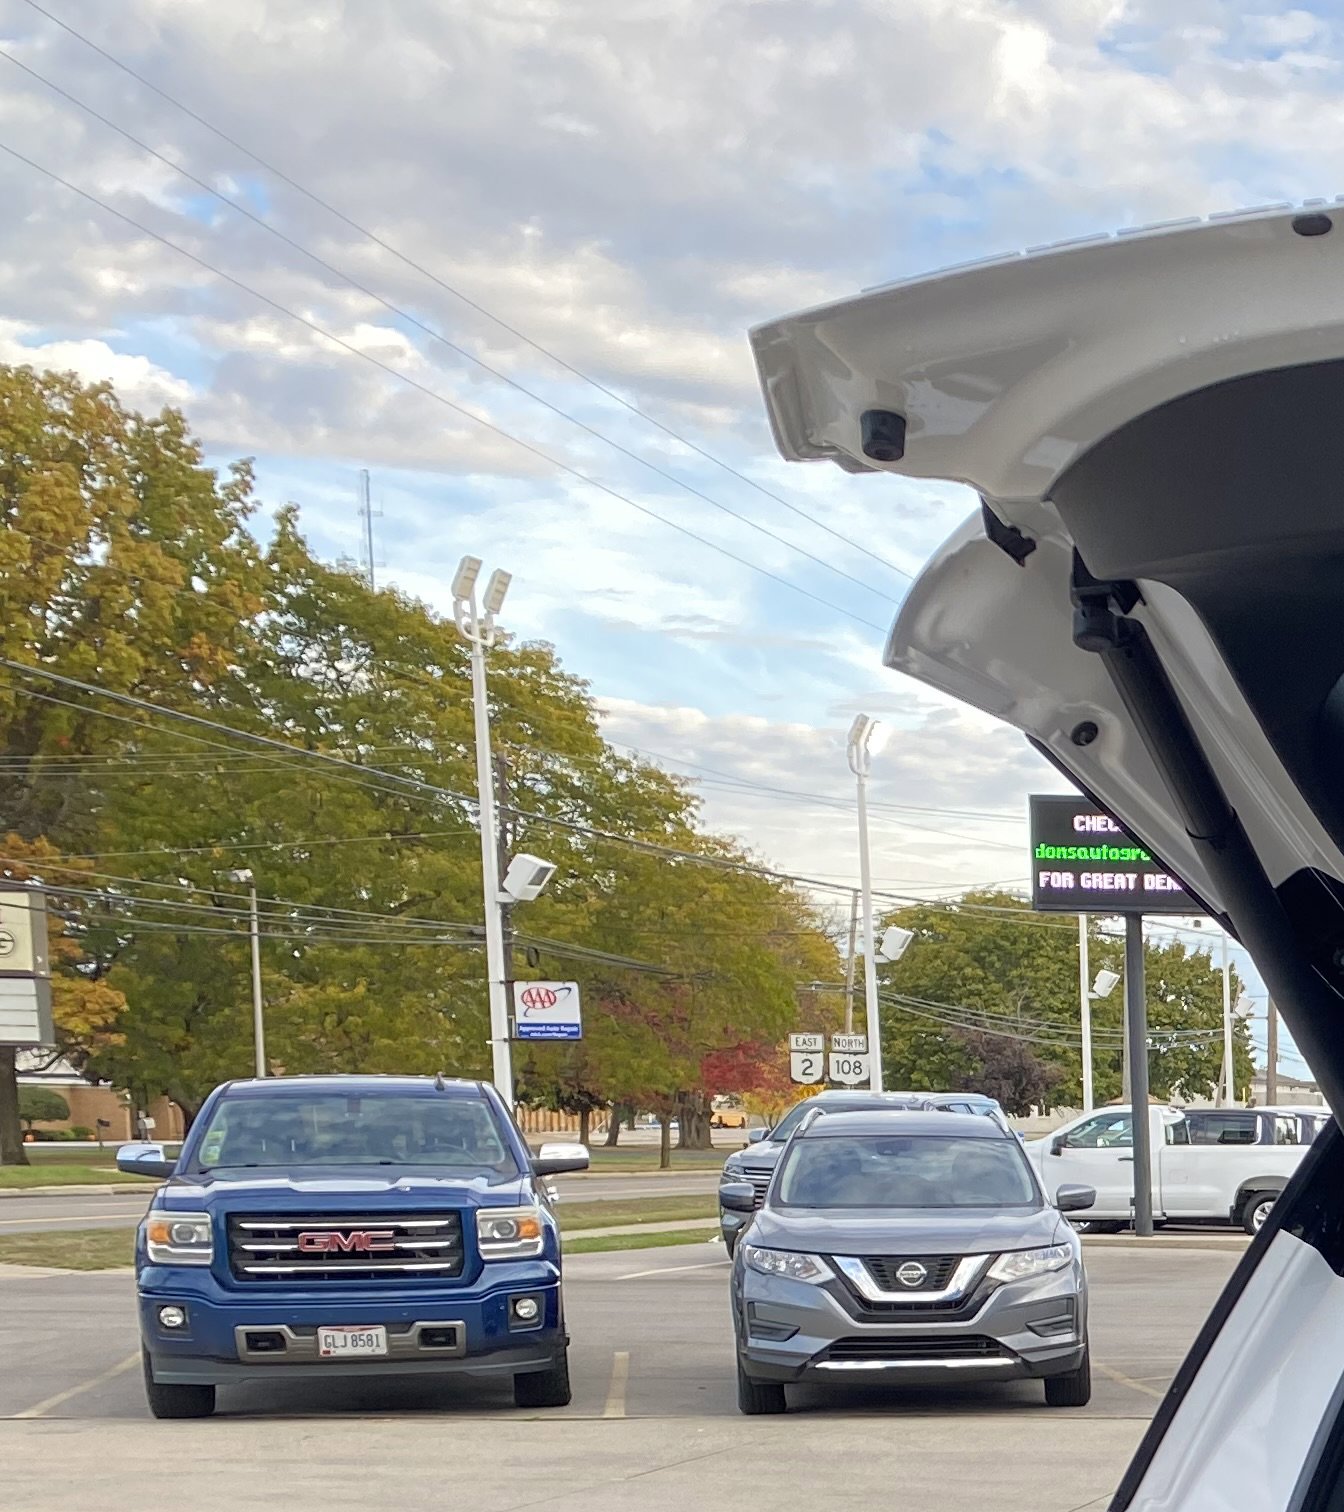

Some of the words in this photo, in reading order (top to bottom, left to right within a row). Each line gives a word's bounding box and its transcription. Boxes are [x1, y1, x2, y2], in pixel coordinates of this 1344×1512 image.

[1073, 815, 1122, 832] CHEC
[1039, 871, 1074, 889] FOR
[1080, 872, 1138, 890] GREAT
[1143, 873, 1183, 890] DEA
[522, 987, 555, 1009] AAA
[795, 1037, 817, 1047] EAST
[833, 1037, 864, 1048] NORTH
[801, 1058, 814, 1076] 2
[835, 1060, 863, 1076] 108
[298, 1230, 395, 1252] GMC
[324, 1334, 348, 1348] GLJ
[350, 1333, 381, 1348] 8581
